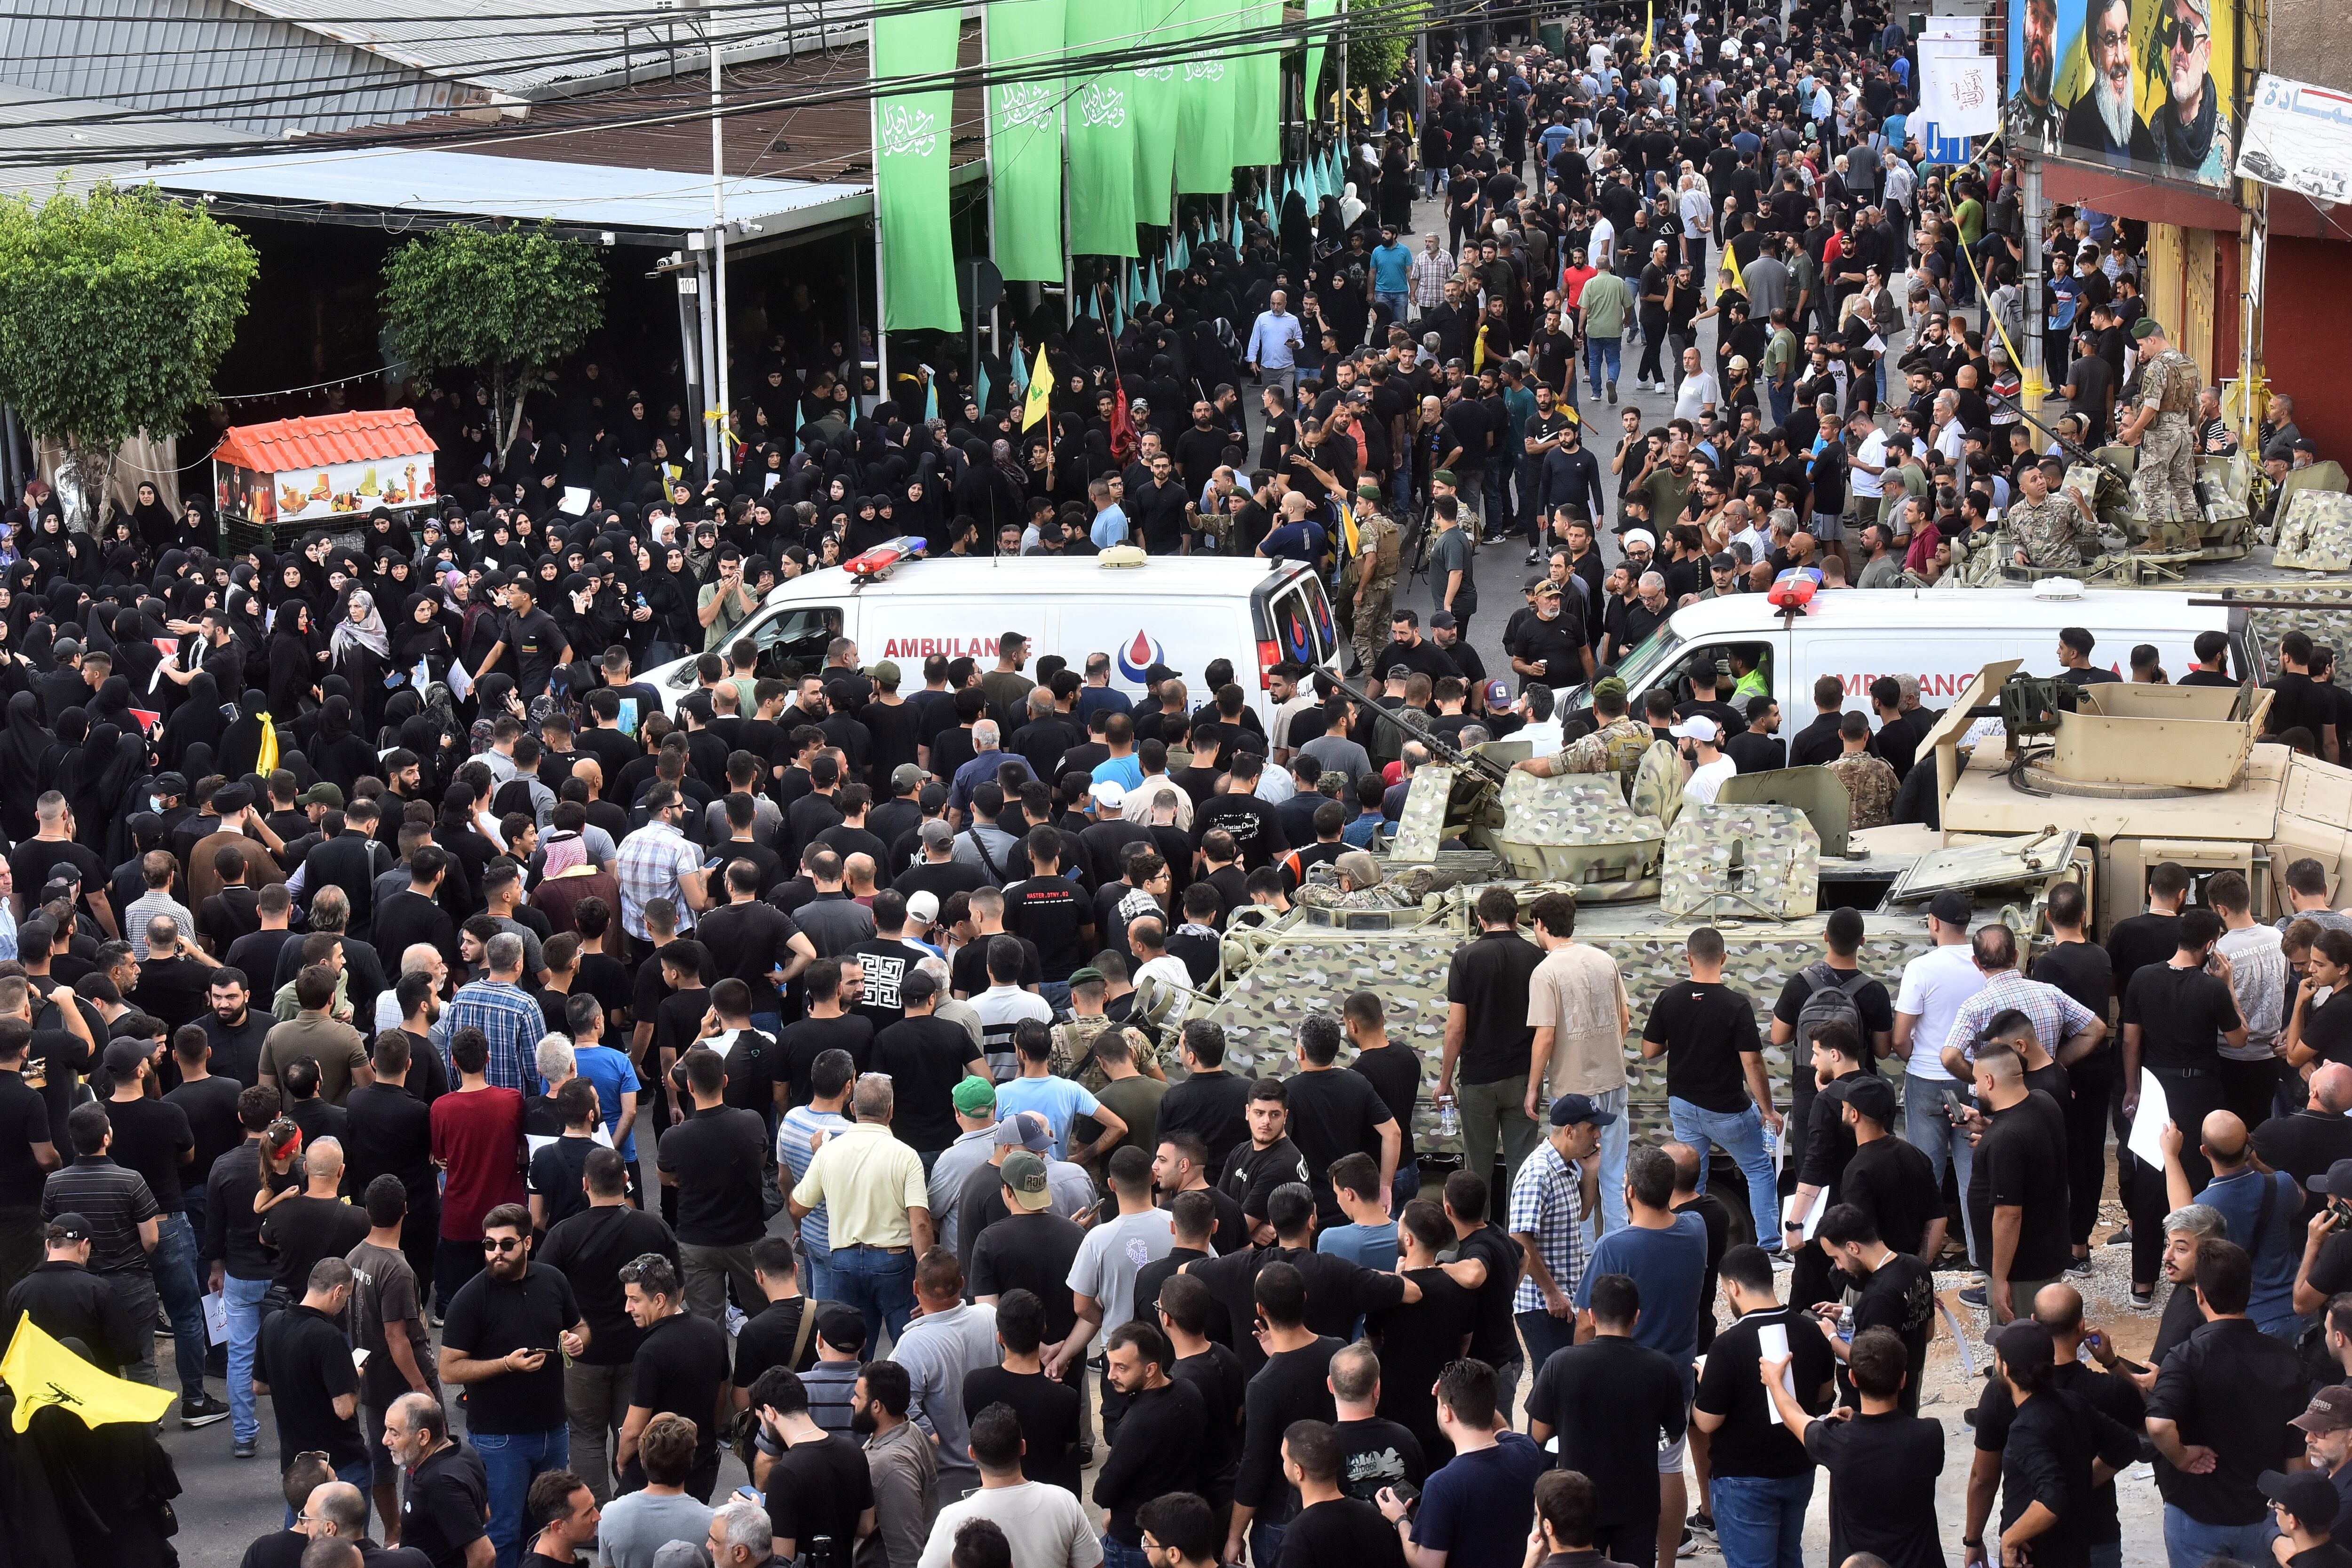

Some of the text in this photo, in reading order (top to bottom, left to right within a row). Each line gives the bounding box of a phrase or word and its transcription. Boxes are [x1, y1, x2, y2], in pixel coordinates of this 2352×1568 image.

[681, 279, 695, 294] 101
[884, 637, 1032, 658] AMBULANE
[1819, 673, 1977, 697] MBANC
